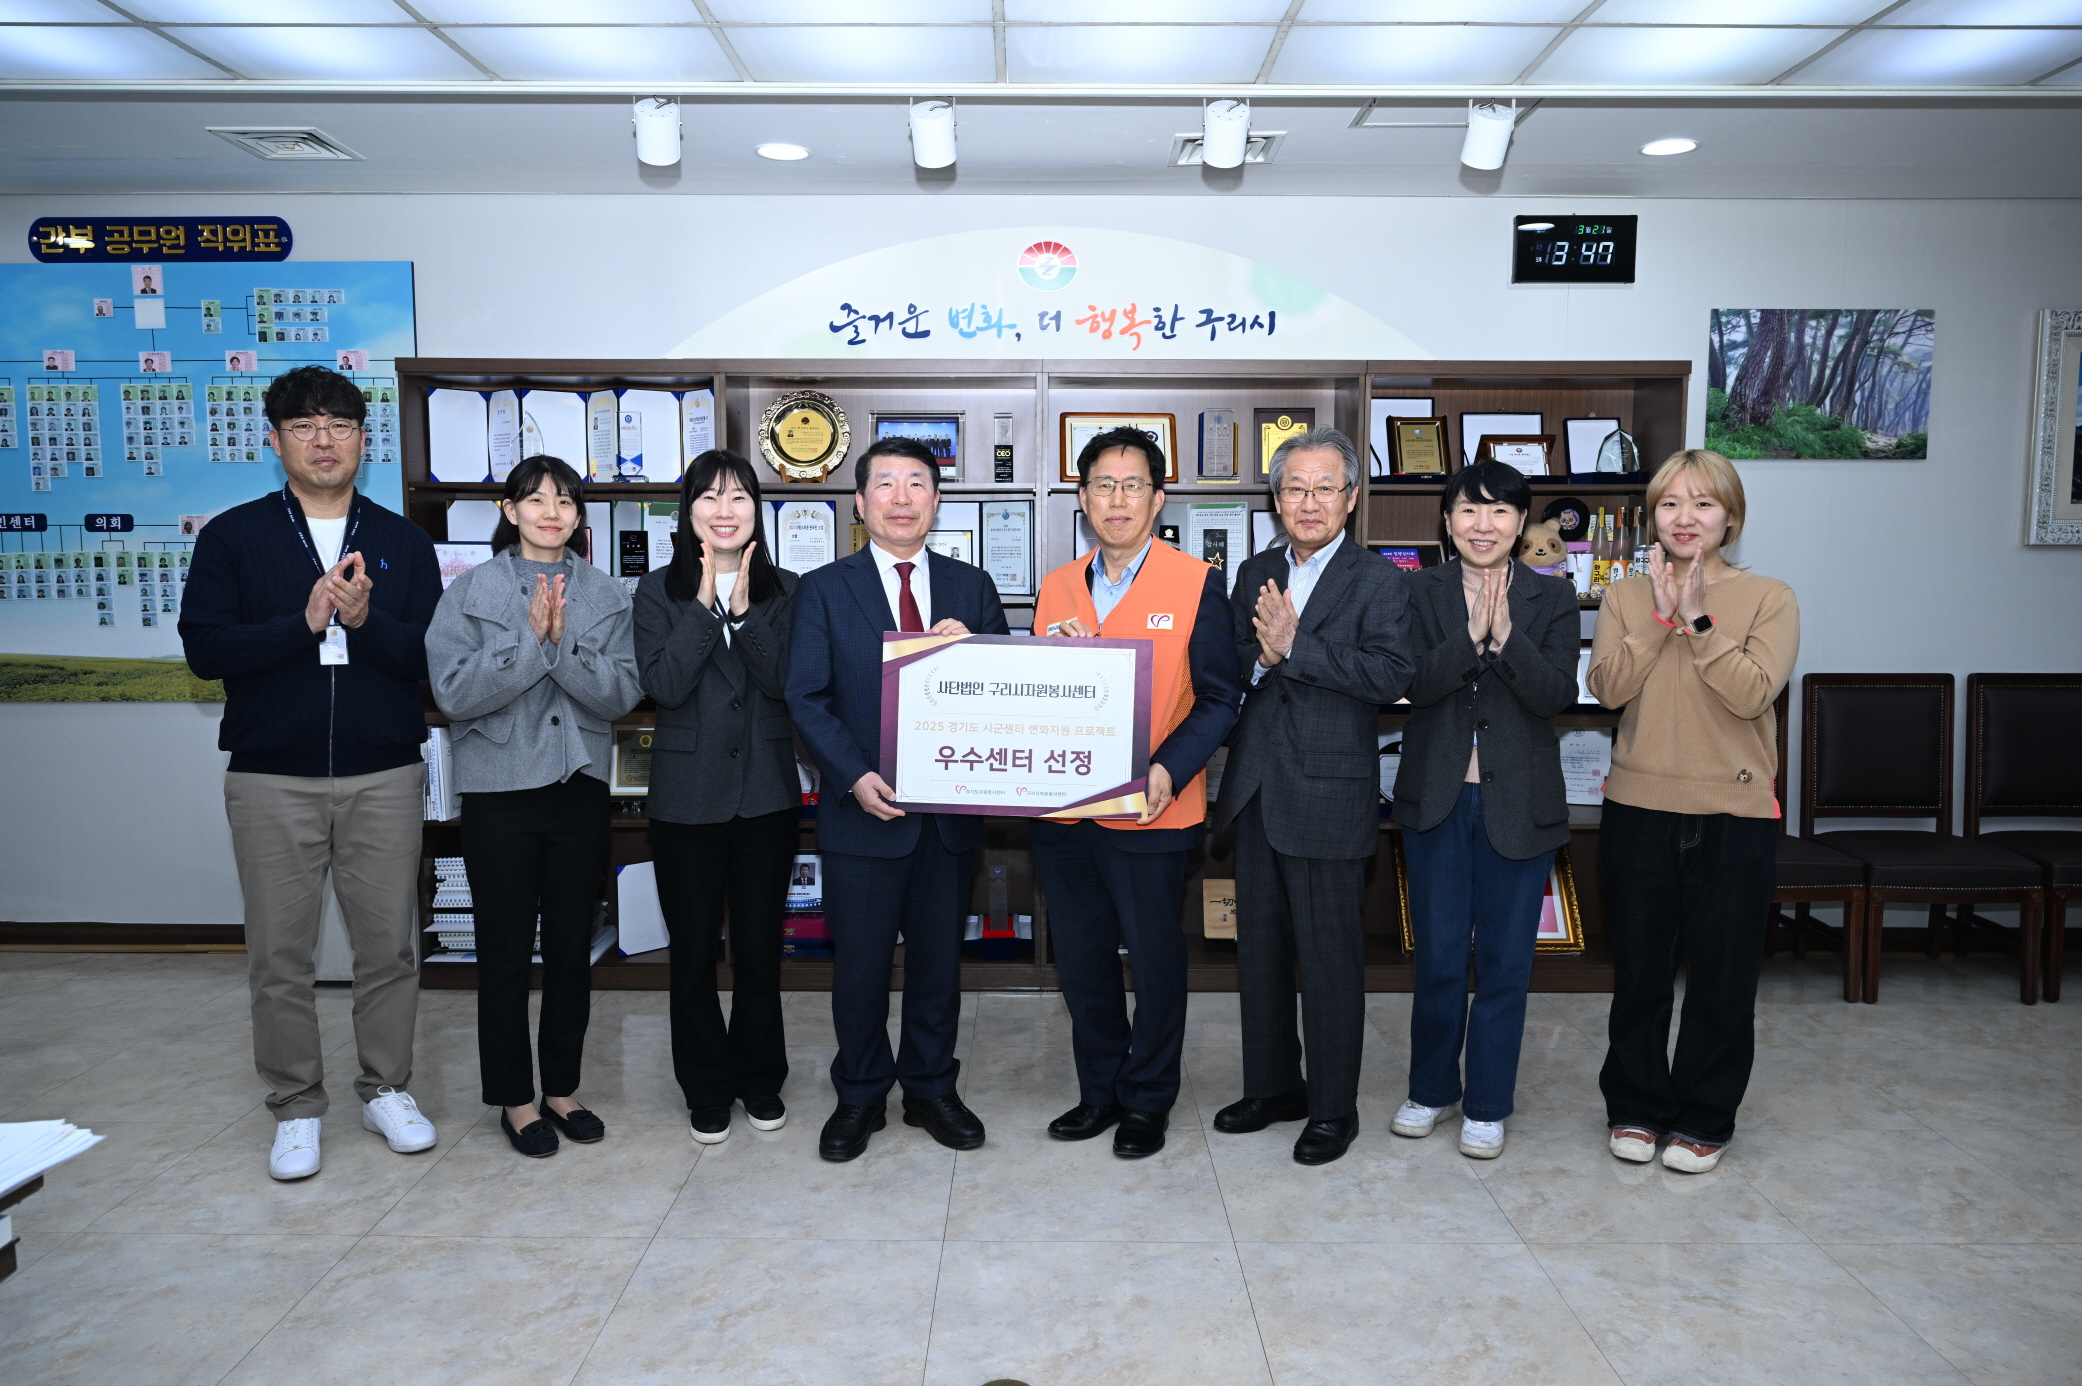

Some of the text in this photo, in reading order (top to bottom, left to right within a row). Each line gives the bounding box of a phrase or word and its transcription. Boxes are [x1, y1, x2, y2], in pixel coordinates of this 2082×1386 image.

[38, 224, 282, 254] 간부 공무원 직위표
[829, 302, 1276, 351] 즐거운 변화, 더 행복한 구리시
[95, 516, 121, 530] 의회
[937, 680, 1096, 699] 사단법인 구리시자원봉사센터
[914, 721, 1117, 737] 2025 경기도 시군센터 변화지원 프로젝트
[934, 745, 1092, 776] 우수센터 선정
[966, 788, 1006, 796] 경기도자원봉사센터
[1026, 790, 1067, 798] 구리시자원봉사센터
[1210, 897, 1236, 906] 一切
